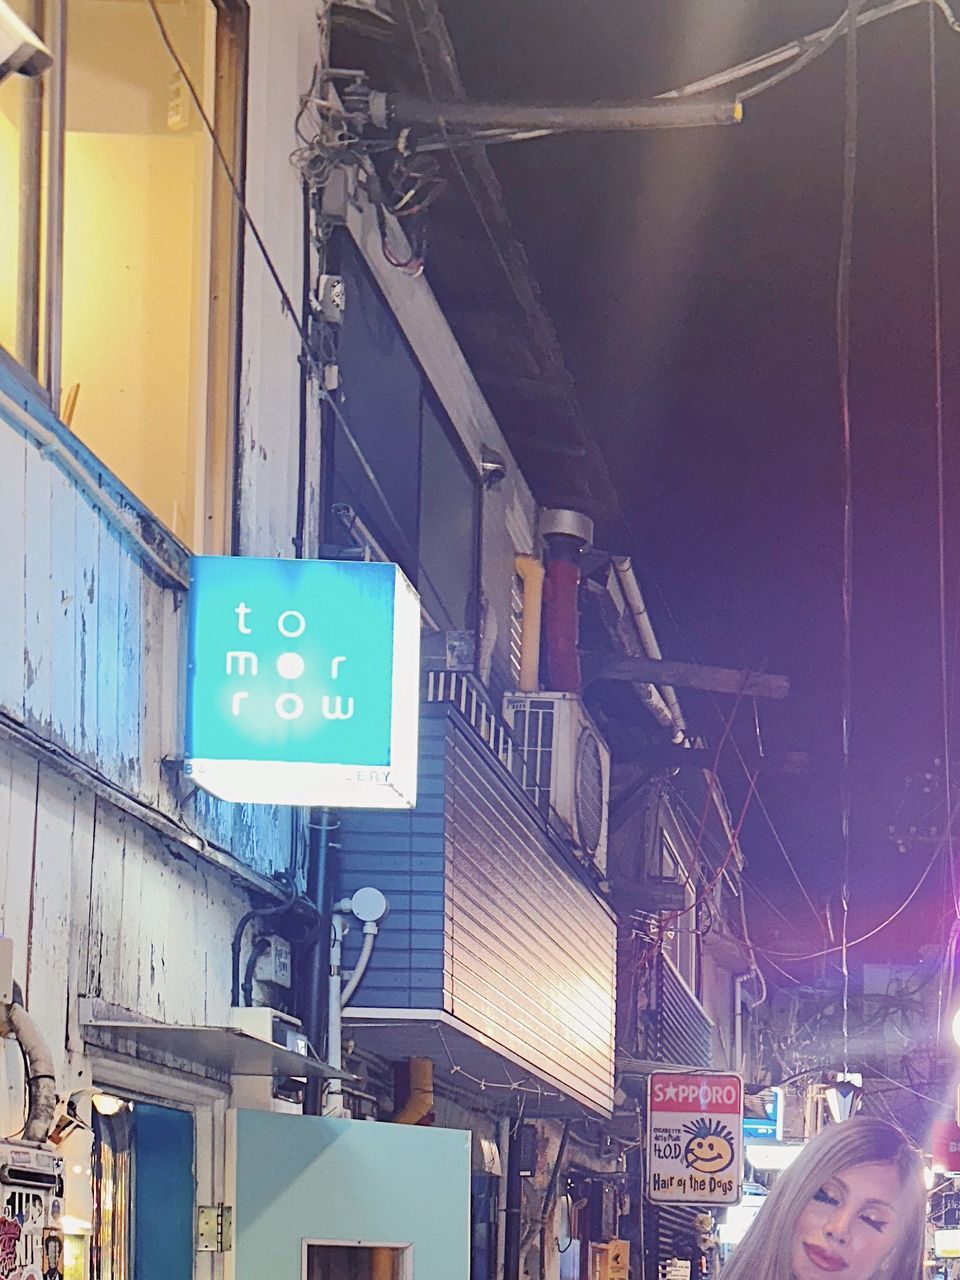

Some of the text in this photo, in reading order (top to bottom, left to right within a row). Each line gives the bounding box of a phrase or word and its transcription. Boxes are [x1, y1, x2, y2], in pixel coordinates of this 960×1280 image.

[653, 1174, 733, 1195] Hair of the Dogs
